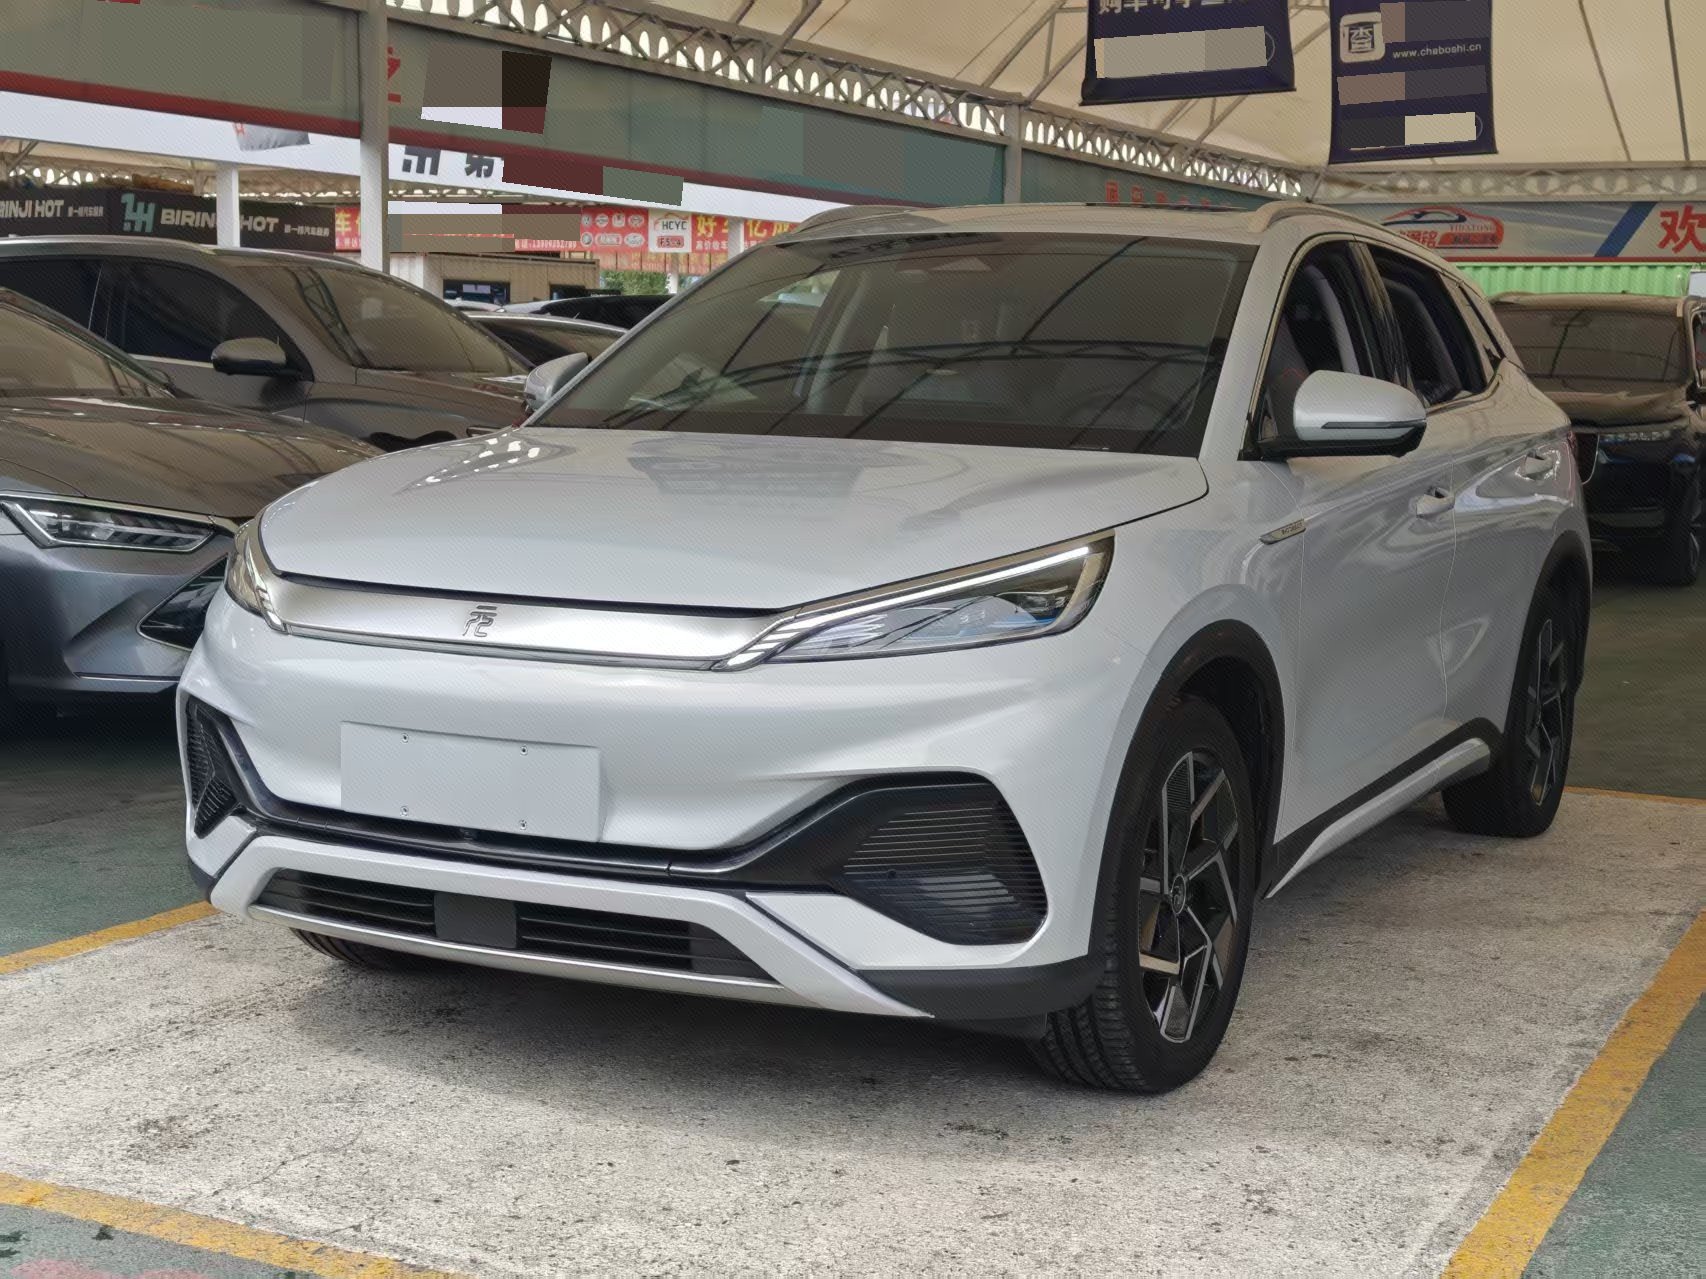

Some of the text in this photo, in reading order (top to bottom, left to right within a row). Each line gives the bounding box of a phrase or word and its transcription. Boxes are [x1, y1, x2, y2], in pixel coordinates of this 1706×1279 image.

[1392, 43, 1482, 59] www.chaboshi.cn
[34, 199, 65, 218] HOT
[160, 208, 279, 233] BIRIN HOT
[662, 220, 688, 231] HCYC
[1656, 203, 1706, 254] 欢
